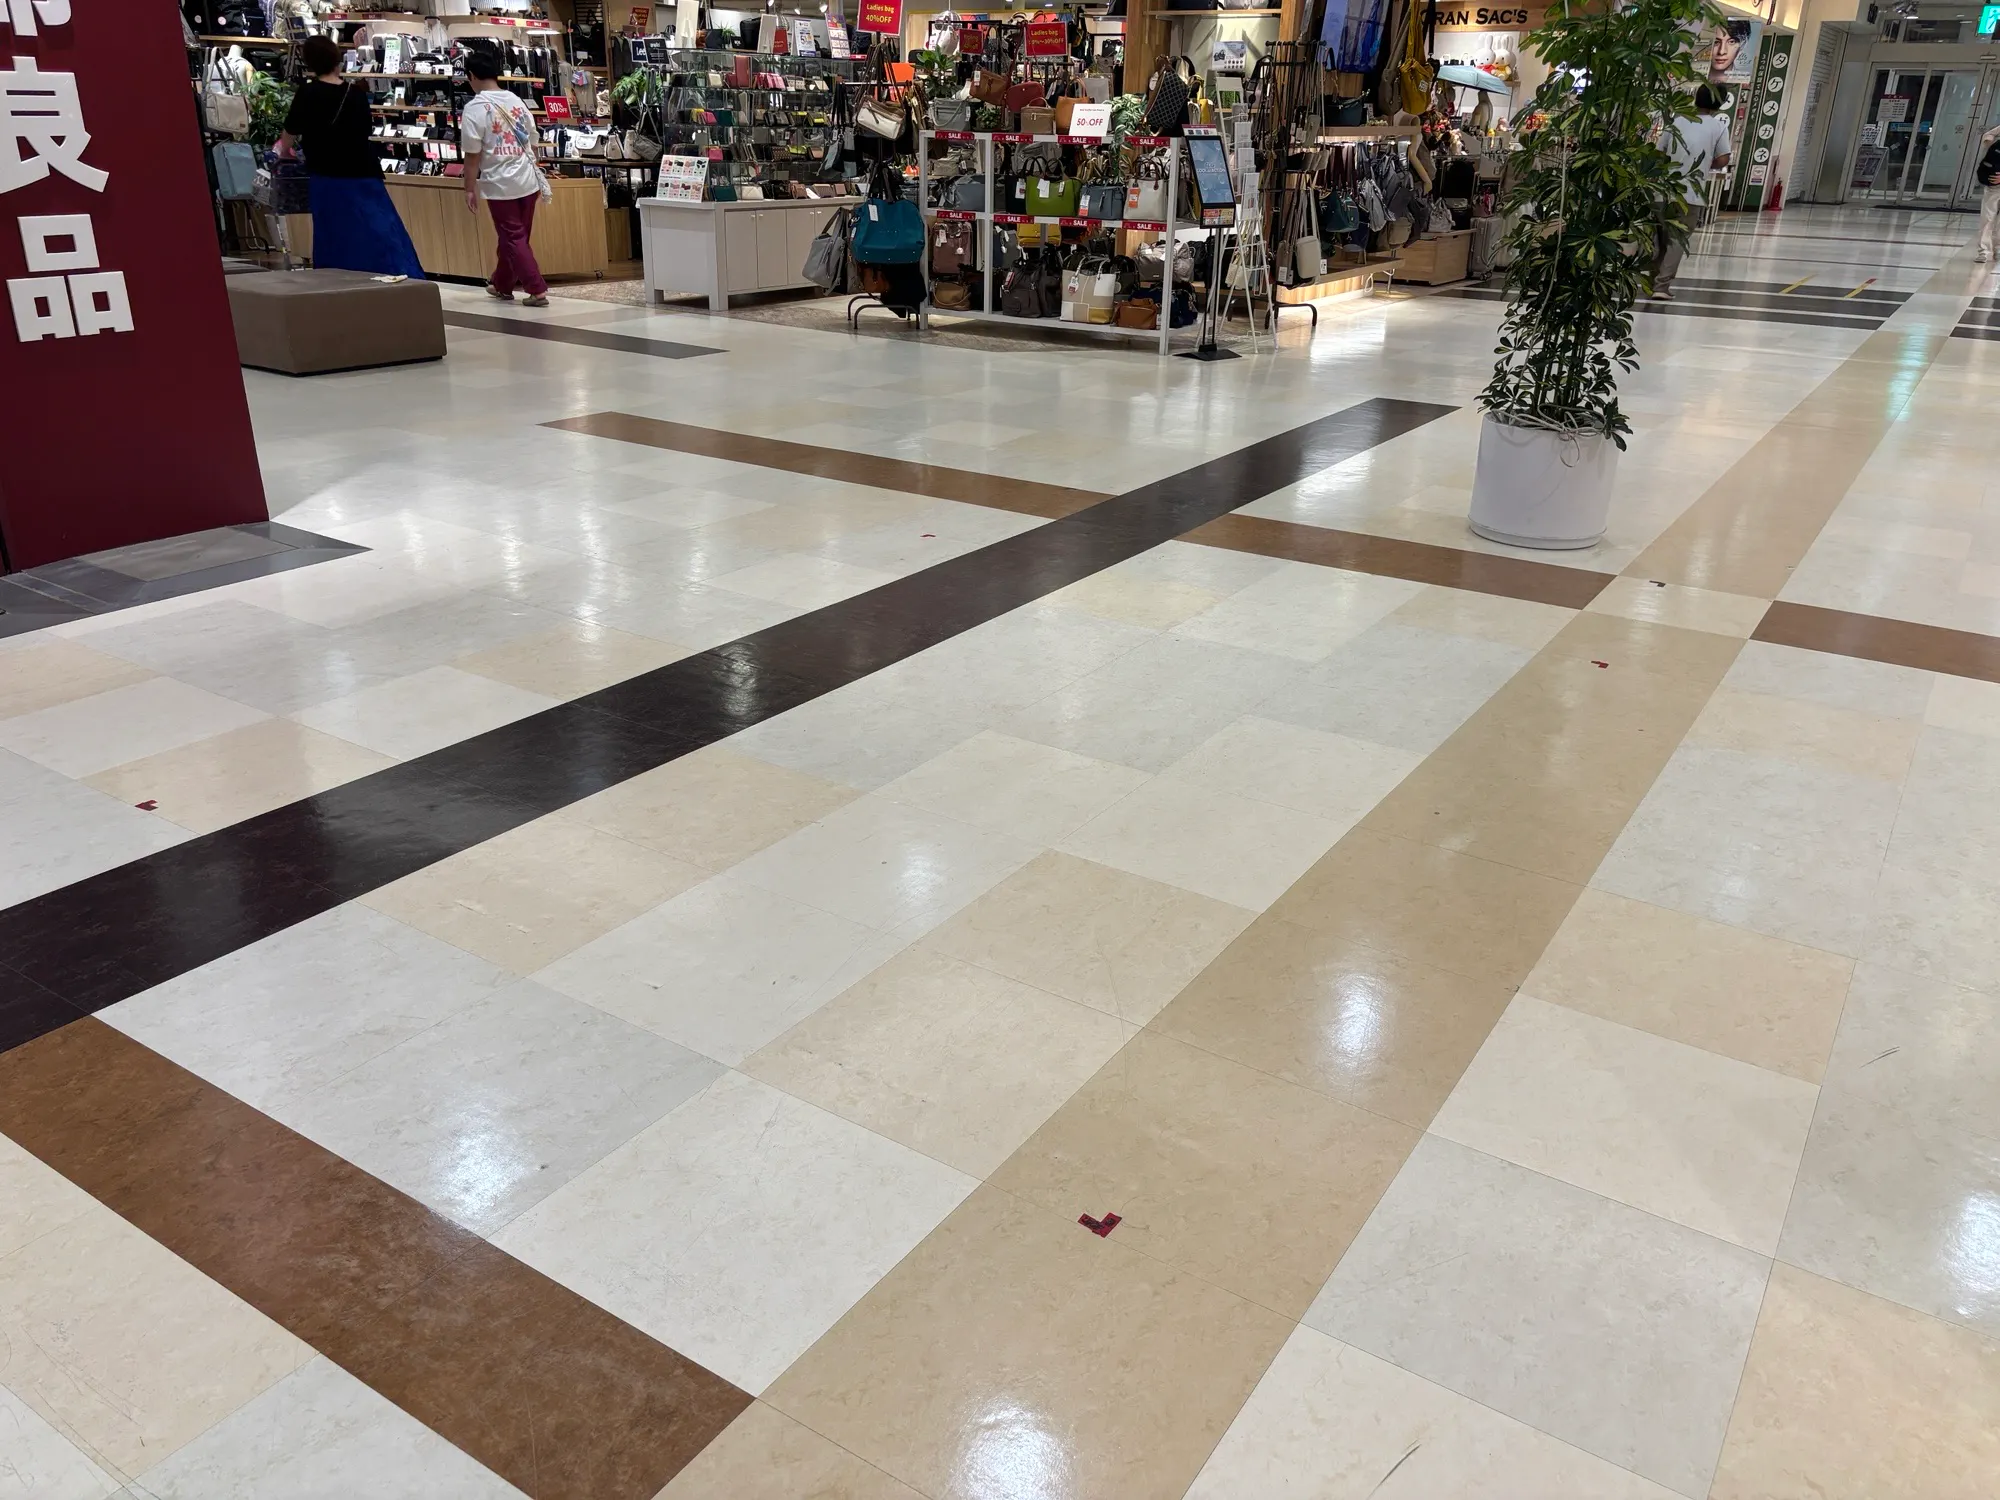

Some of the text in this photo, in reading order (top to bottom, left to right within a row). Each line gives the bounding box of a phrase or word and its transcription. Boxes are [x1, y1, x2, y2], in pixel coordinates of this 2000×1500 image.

[885, 5, 894, 13] bag
[1476, 8, 1528, 24] SAC'S
[866, 15, 892, 23] 40%OFF
[1756, 54, 1787, 160] タケメガネ
[0, 0, 134, 342] 良品
